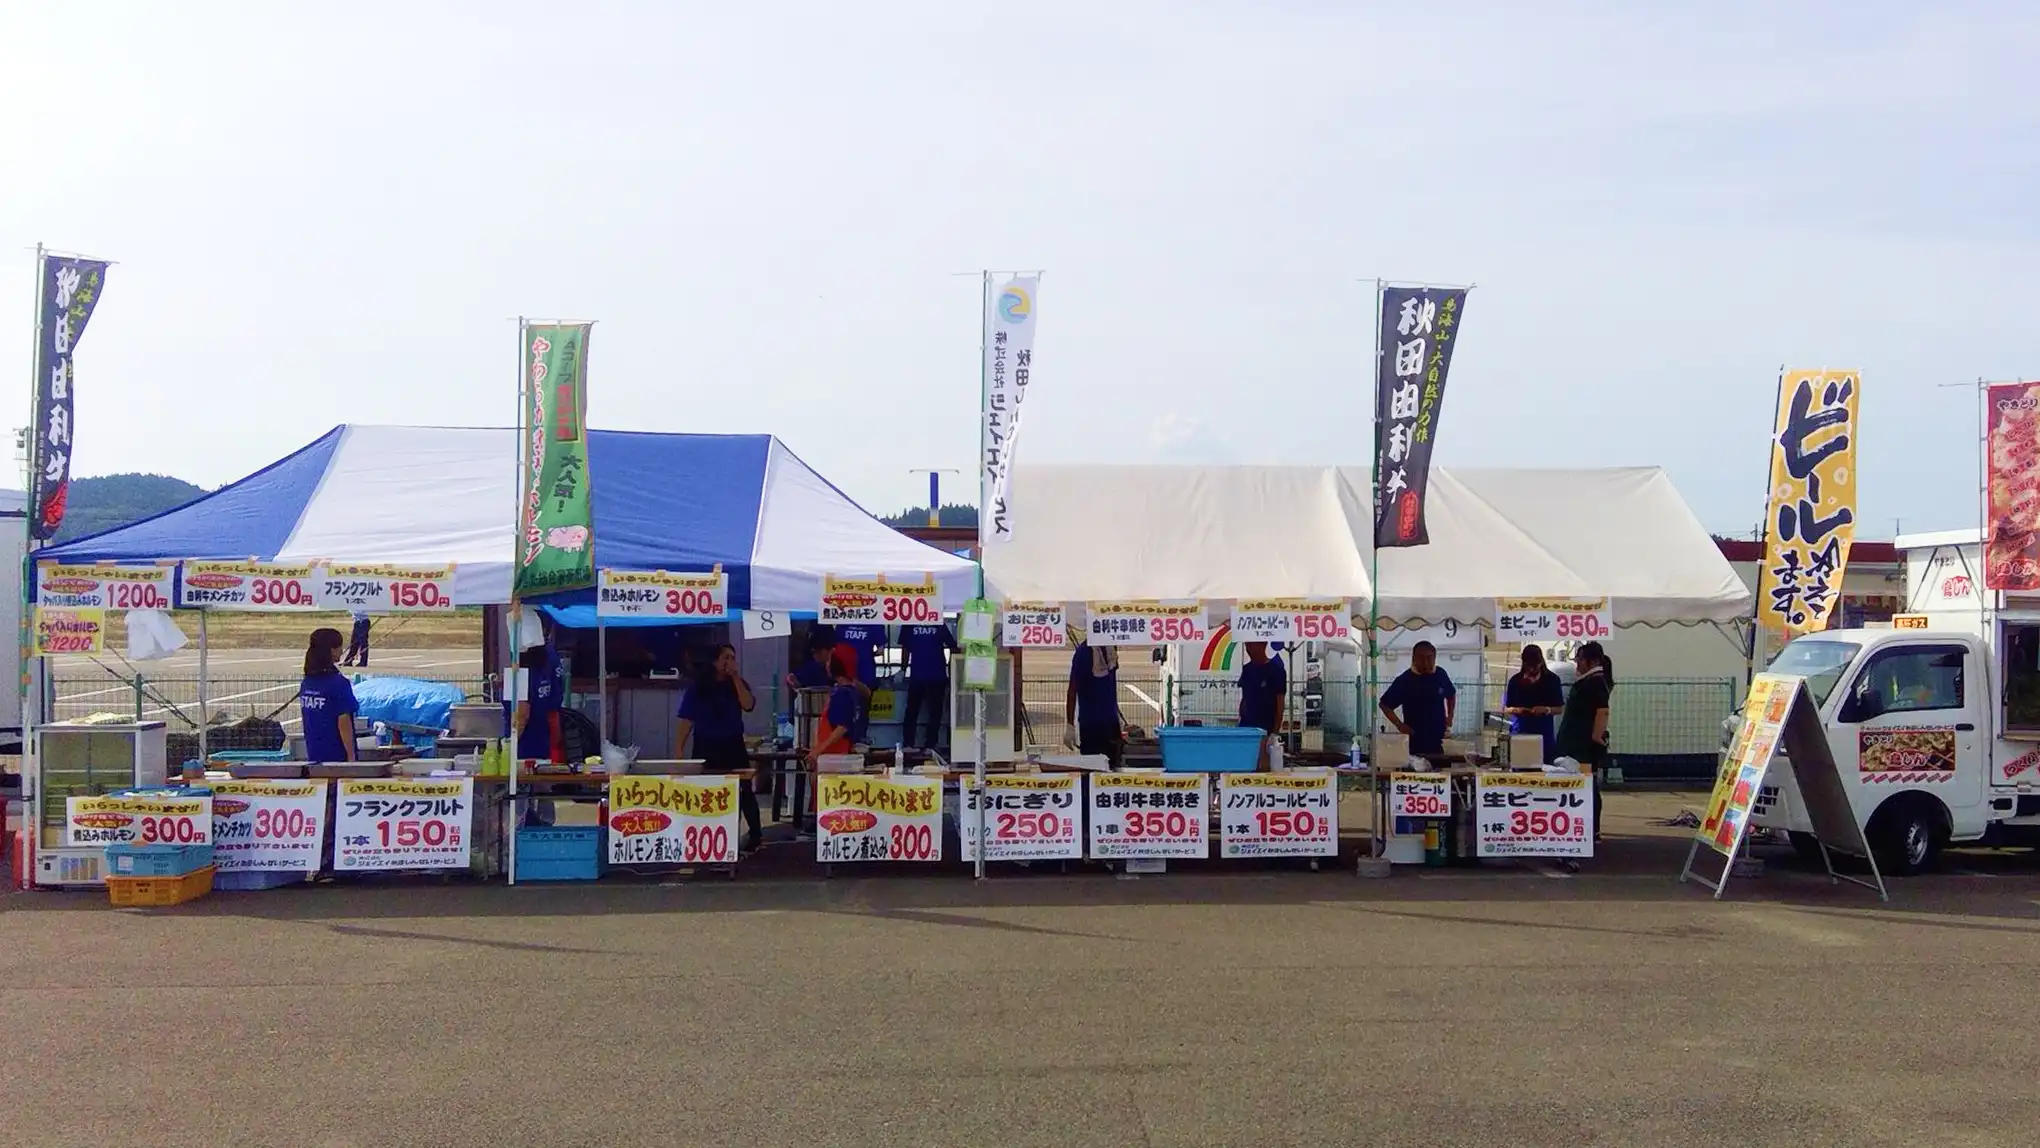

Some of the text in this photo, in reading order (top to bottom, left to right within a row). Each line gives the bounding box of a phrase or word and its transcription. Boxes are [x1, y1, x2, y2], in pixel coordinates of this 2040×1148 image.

[1387, 297, 1435, 503] 秋田由利牛
[1779, 376, 1853, 545] ビール
[107, 584, 168, 608] 1200円
[251, 579, 313, 605] 300円
[325, 581, 383, 596] フランクフルト
[389, 582, 450, 607] 150円
[602, 588, 660, 602] 煮込みホルモン
[1772, 549, 1805, 624] ます。
[665, 590, 723, 615] 300円
[883, 597, 939, 622] 300円
[761, 611, 774, 631] 8
[823, 607, 878, 620] 煮込みホルモン
[1008, 614, 1061, 625] おにぎり
[1500, 615, 1550, 629] 生ビール
[913, 627, 937, 636] STAFF
[1022, 626, 1063, 645] 250円
[1150, 617, 1204, 641] 350円
[1294, 614, 1348, 638] 150円
[1445, 616, 1457, 638] 9
[1556, 614, 1609, 637] 350円
[300, 696, 326, 710] STAFF
[215, 786, 315, 795] らっしゃいませ!!
[616, 780, 731, 814] いらっしゃいませ
[824, 780, 935, 813] いらっしゃいませ
[967, 789, 1073, 810] おにぎり
[1396, 784, 1445, 795] 生ビール
[1483, 791, 1584, 808] 生ビール
[345, 799, 464, 817] フランクフルト
[1096, 792, 1200, 808] 由利牛串焼き
[1227, 792, 1330, 808] ノンアルコールビール
[1405, 796, 1448, 814] 350円
[73, 829, 136, 842] 煮込みホルモン
[141, 816, 206, 843] 300円
[1227, 823, 1250, 834] 1本
[342, 835, 370, 846] 1本
[614, 837, 682, 862] ホルモン煮込み
[822, 834, 888, 860] ホルモン煮込み
